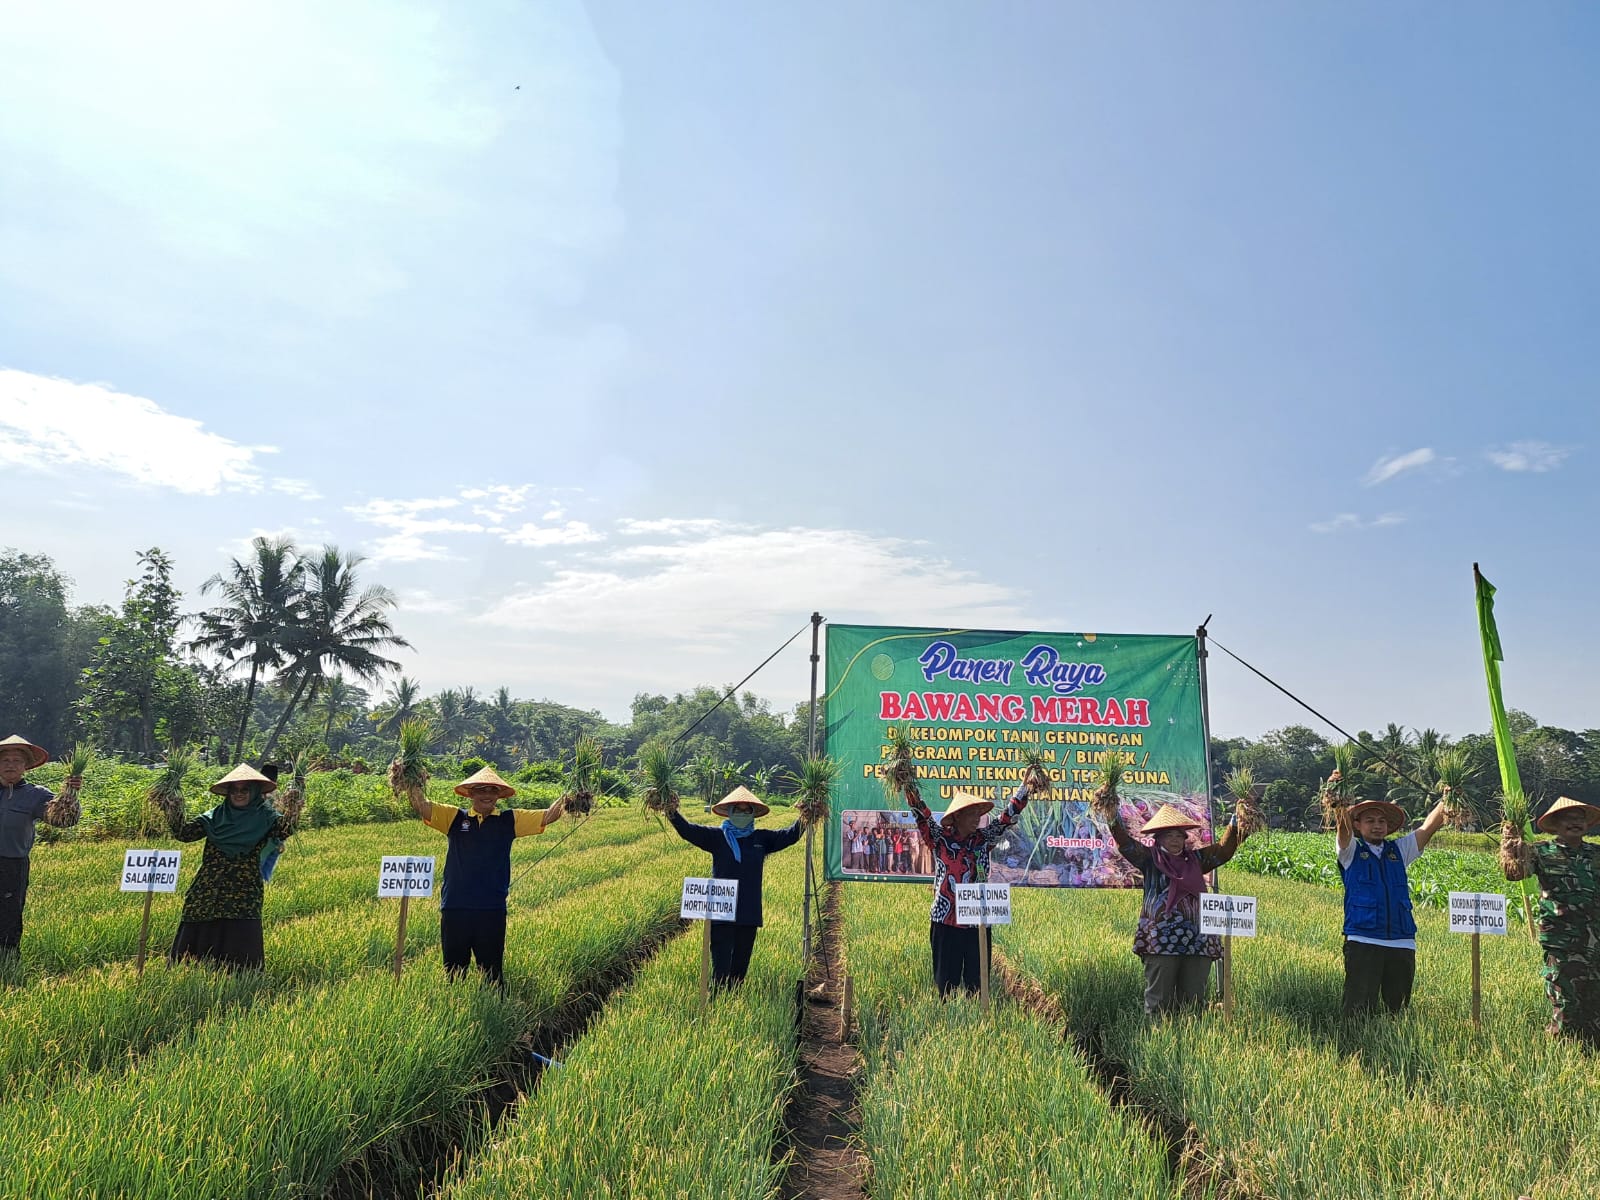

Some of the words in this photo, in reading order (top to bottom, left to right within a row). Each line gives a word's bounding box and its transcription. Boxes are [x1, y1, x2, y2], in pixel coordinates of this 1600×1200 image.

[918, 640, 1015, 686] Panen
[1020, 644, 1107, 694] Raya
[879, 691, 1027, 723] BAWANG
[1031, 695, 1151, 726] MERAH
[910, 727, 997, 743] KELOMPOK
[1001, 729, 1040, 744] TANI
[1045, 731, 1144, 746] GENDINGAN
[880, 744, 963, 760] PGRAM
[1061, 749, 1071, 766] /
[1140, 752, 1150, 768] /
[863, 764, 972, 780] PENALAN
[976, 766, 1067, 782] TEKNOGI
[1122, 770, 1170, 785] GUNA
[1047, 835, 1105, 850] Salamrejo,
[127, 855, 178, 868] LURAH
[383, 862, 432, 873] PANEWU
[125, 872, 175, 884] SALAMREJO
[382, 878, 430, 890] SENTOLO
[685, 884, 710, 896] KEPALA
[711, 885, 735, 897] BIDANG
[958, 889, 985, 900] KEPALA
[986, 889, 1008, 900] DINAS
[683, 900, 733, 913] HORTIKULTURA
[1202, 899, 1235, 912] KEPALA
[1236, 902, 1254, 913] UPT
[1451, 914, 1467, 925] BPP
[1468, 915, 1504, 927] SENTOLO
